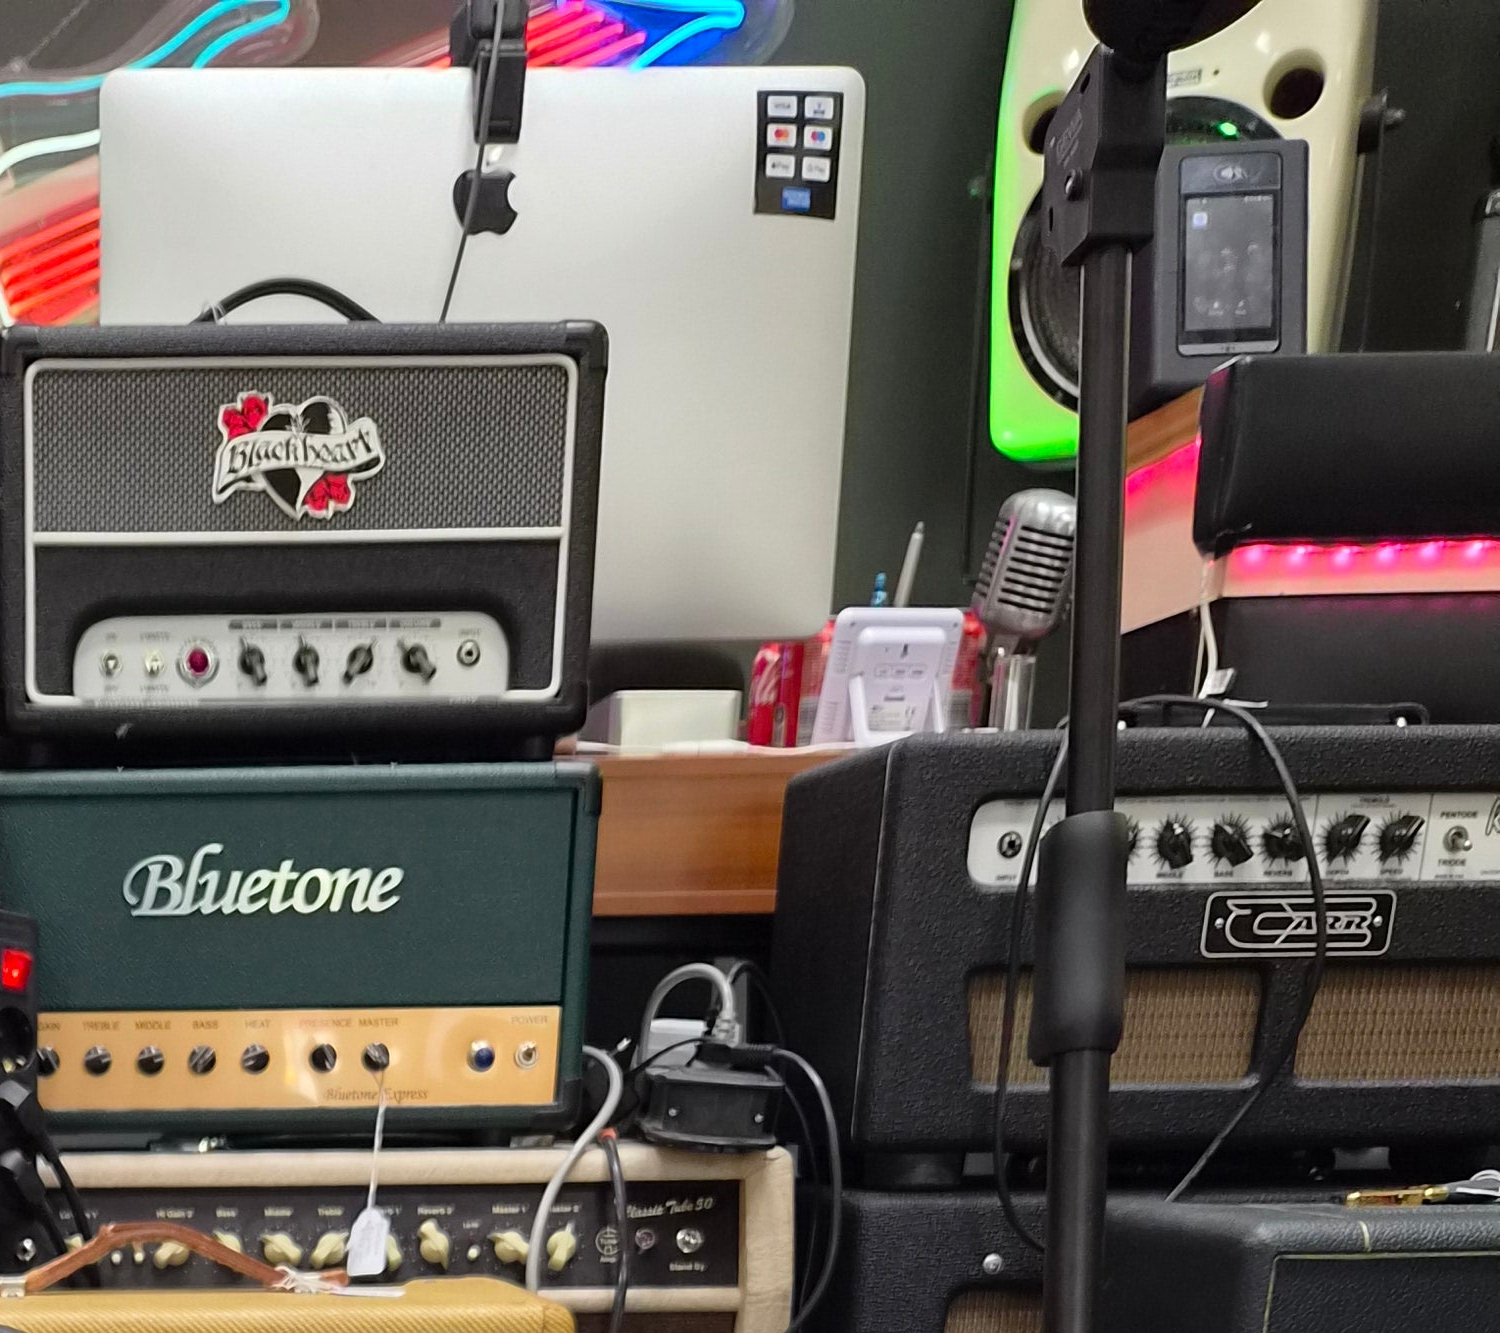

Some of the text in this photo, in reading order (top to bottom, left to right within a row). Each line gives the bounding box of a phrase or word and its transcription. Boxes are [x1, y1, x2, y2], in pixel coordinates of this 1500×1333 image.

[122, 842, 405, 918] Bluetone
[192, 1020, 219, 1030] BASS
[358, 1017, 399, 1028] MASTER
[511, 1014, 548, 1025] POWER
[83, 1021, 120, 1032] TREBLE
[135, 1020, 171, 1031] MIDDLE
